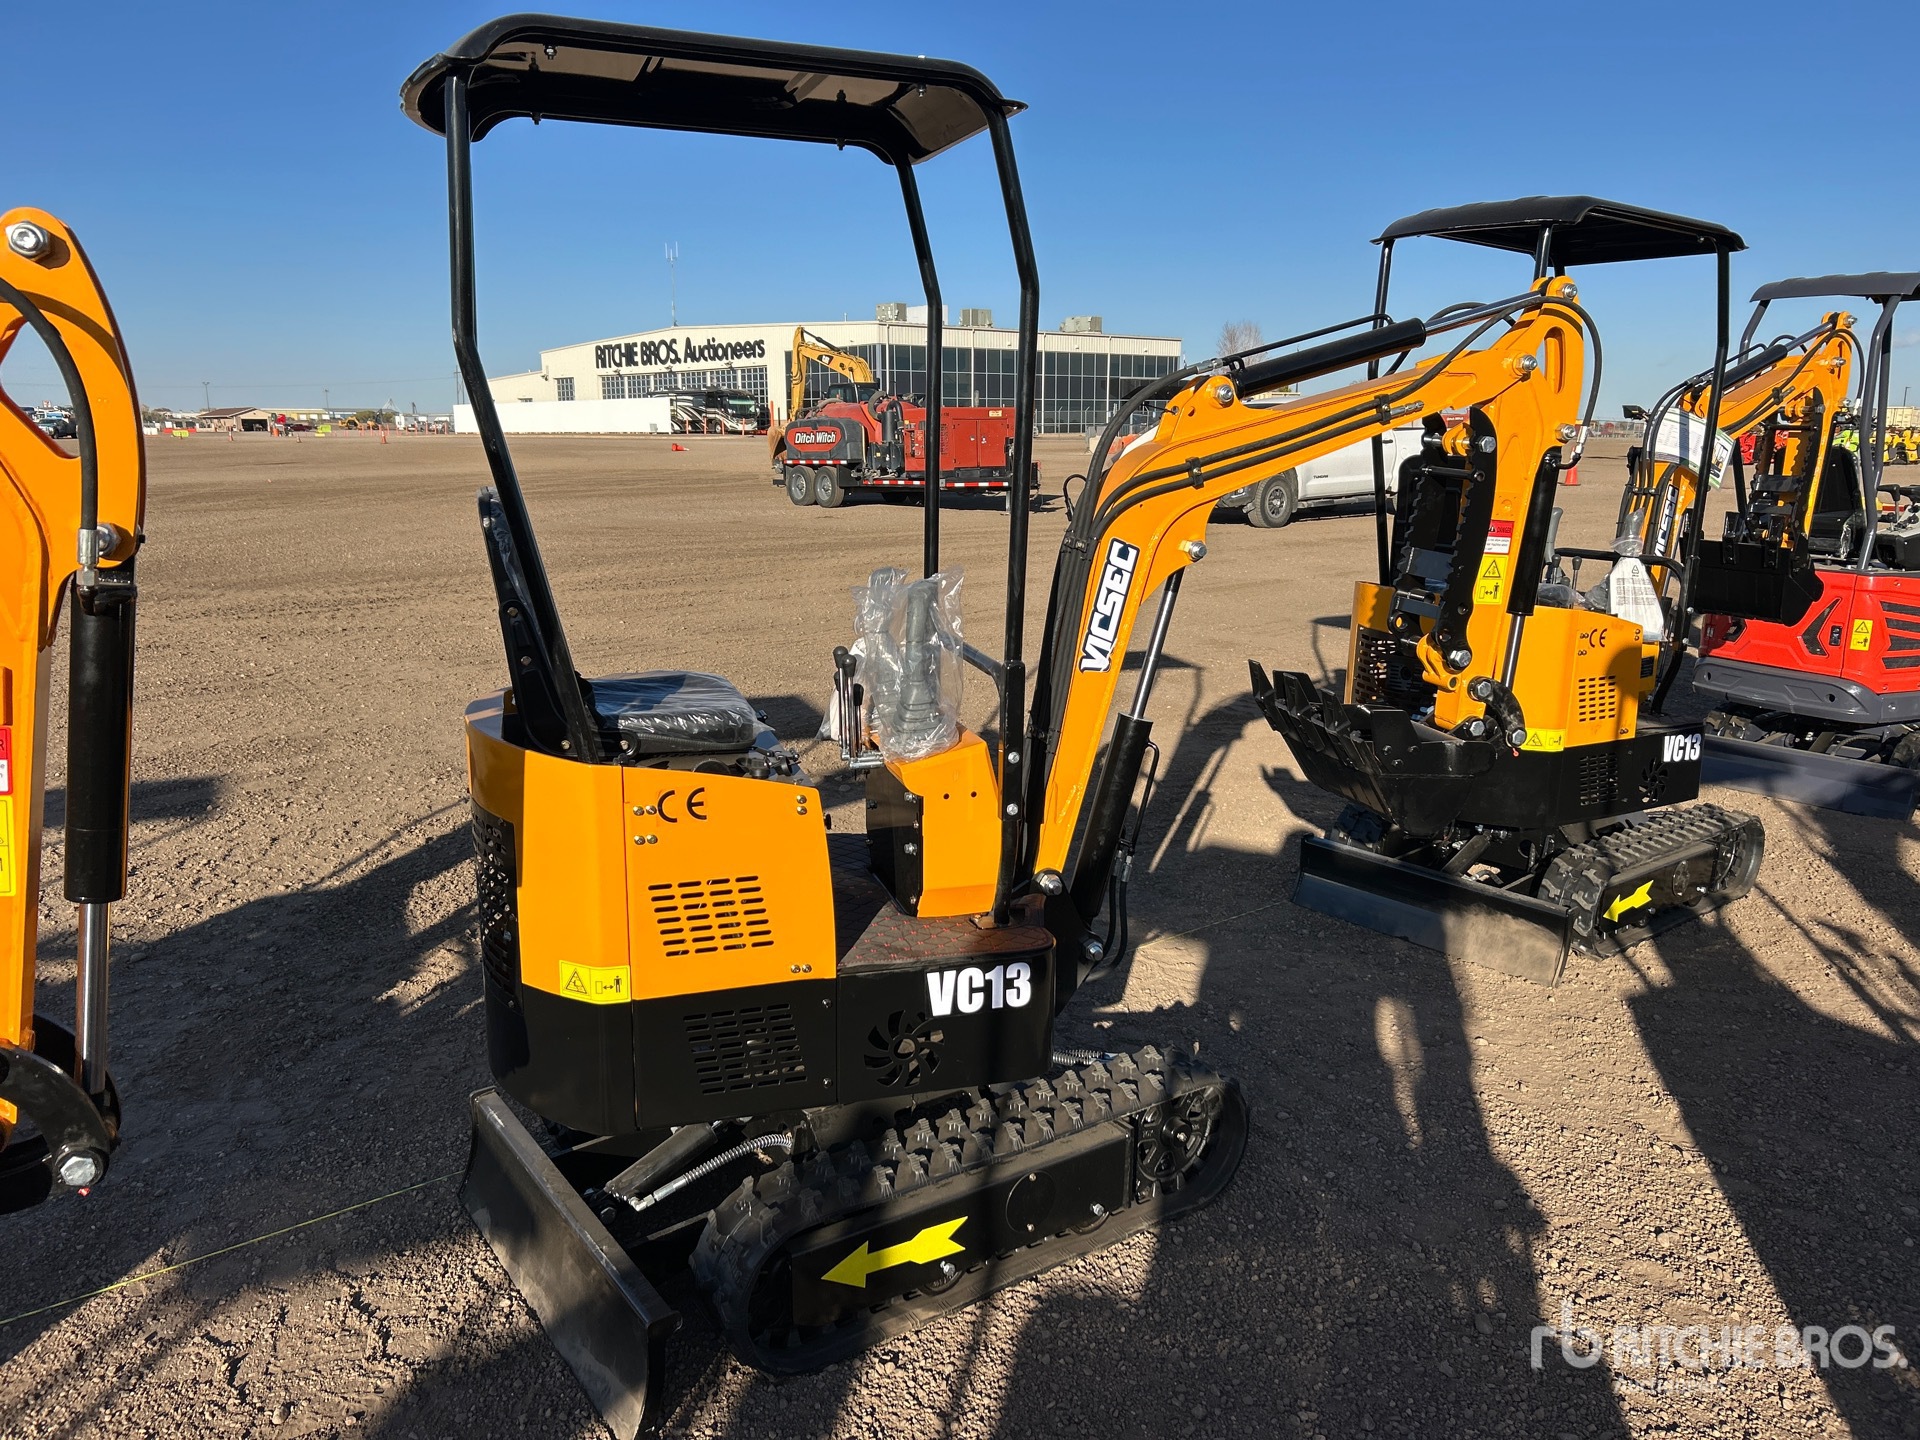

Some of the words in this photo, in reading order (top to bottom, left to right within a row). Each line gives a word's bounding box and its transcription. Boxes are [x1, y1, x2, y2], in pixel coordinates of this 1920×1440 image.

[595, 341, 638, 369] RITCHIE
[640, 338, 681, 366] BROS.
[684, 337, 766, 363] Auctioneers
[795, 431, 815, 444] Ditch
[816, 431, 836, 443] Witch
[1663, 733, 1702, 763] VC13
[657, 787, 707, 823] CE
[926, 962, 1031, 1017] VC13
